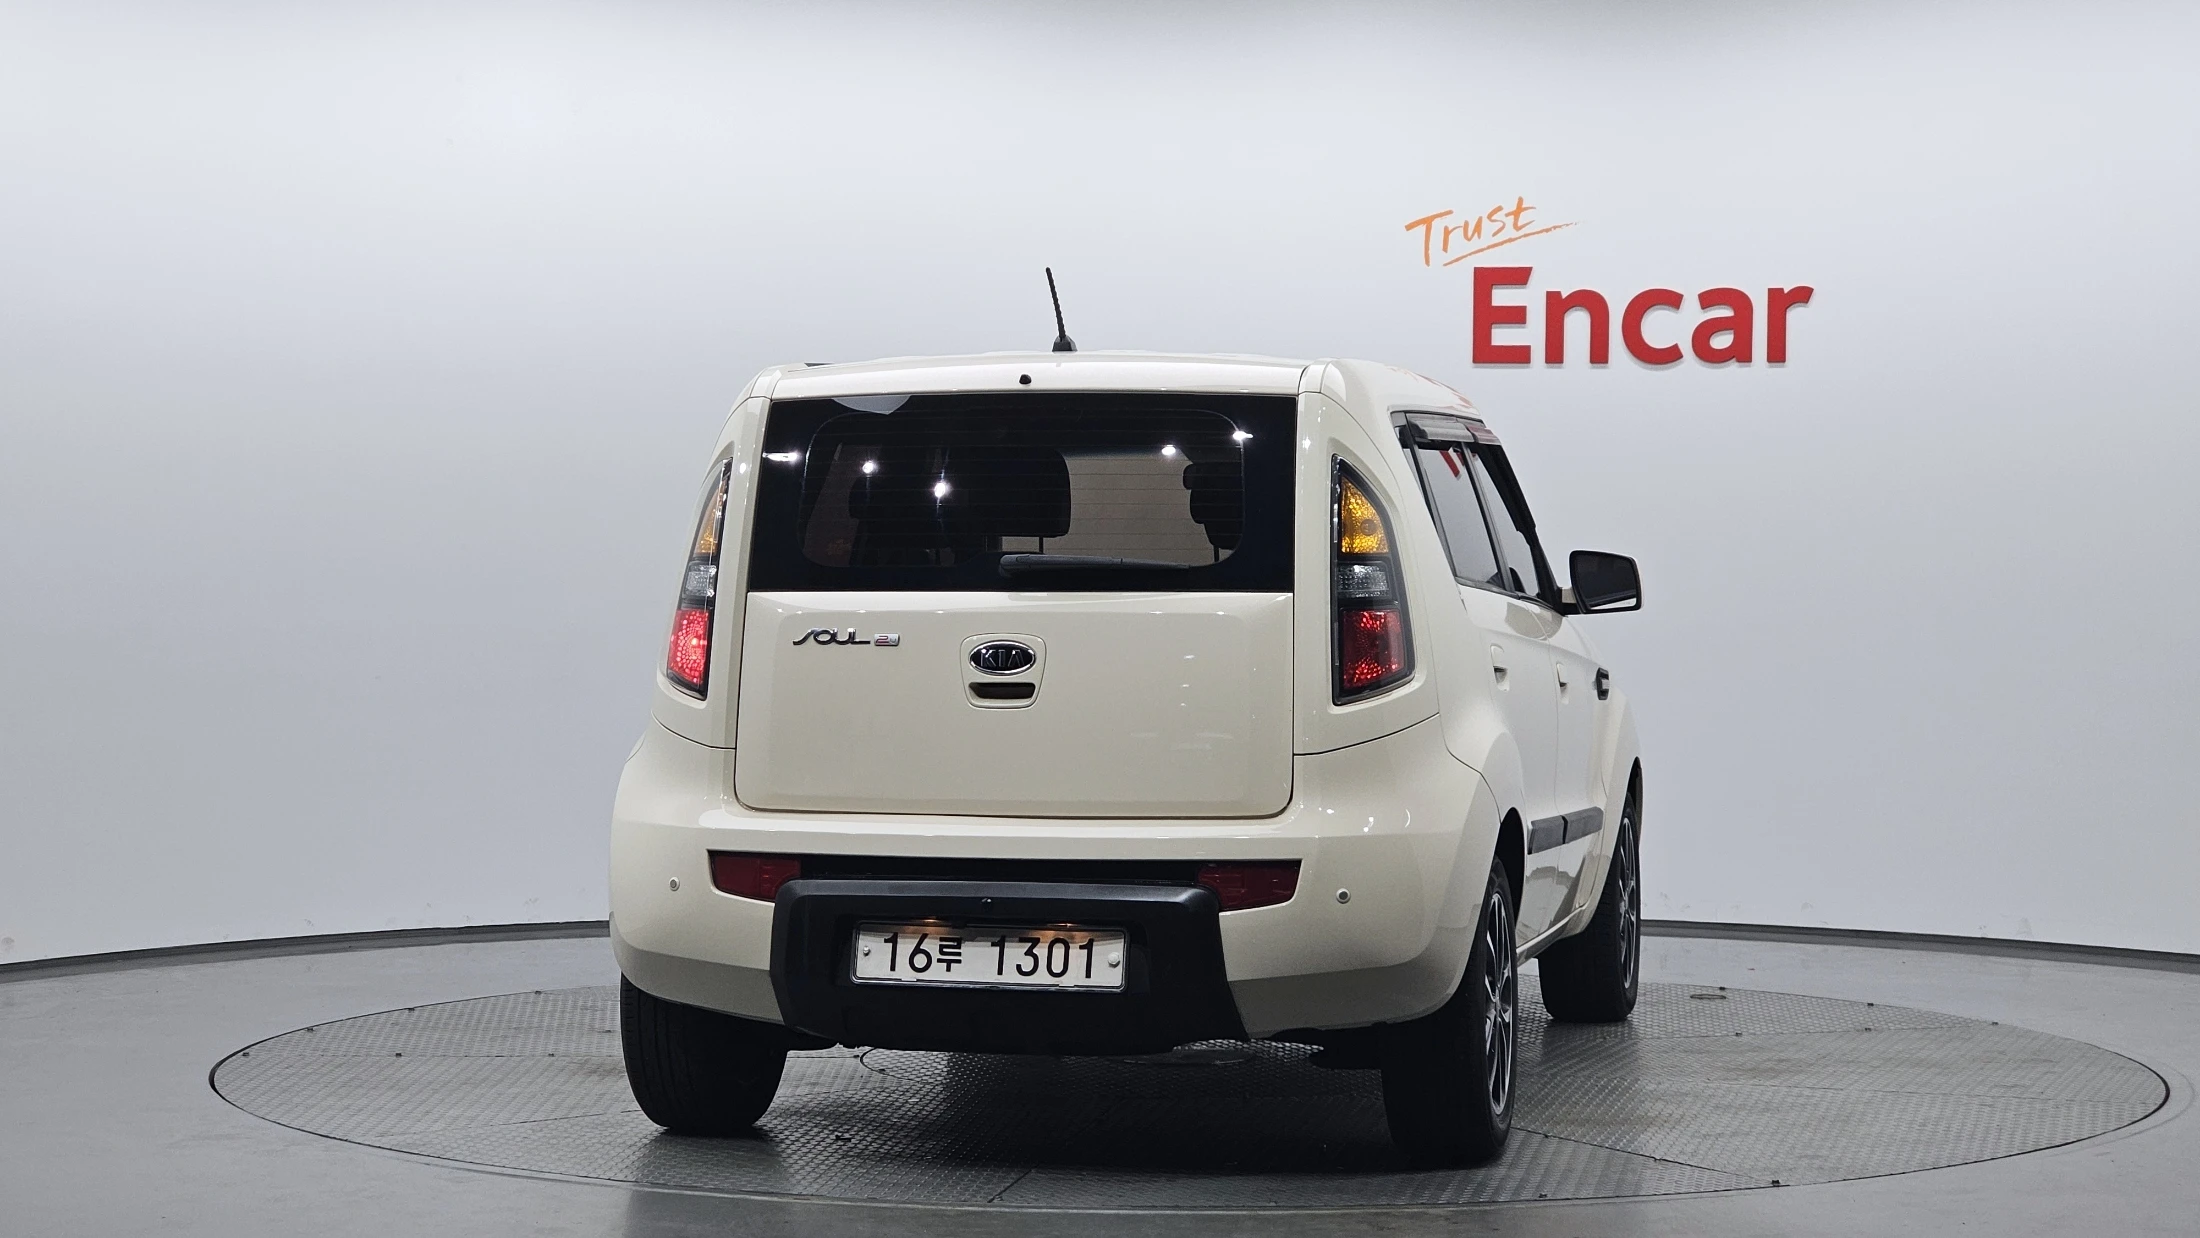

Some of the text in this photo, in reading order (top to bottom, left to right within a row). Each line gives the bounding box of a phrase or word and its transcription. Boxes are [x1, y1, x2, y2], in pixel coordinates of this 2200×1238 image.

[1404, 196, 1538, 266] Trust
[1472, 266, 1815, 366] Encar
[792, 627, 871, 646] SOUL
[979, 649, 1025, 668] KIA
[883, 932, 1095, 979] 16루 1301
